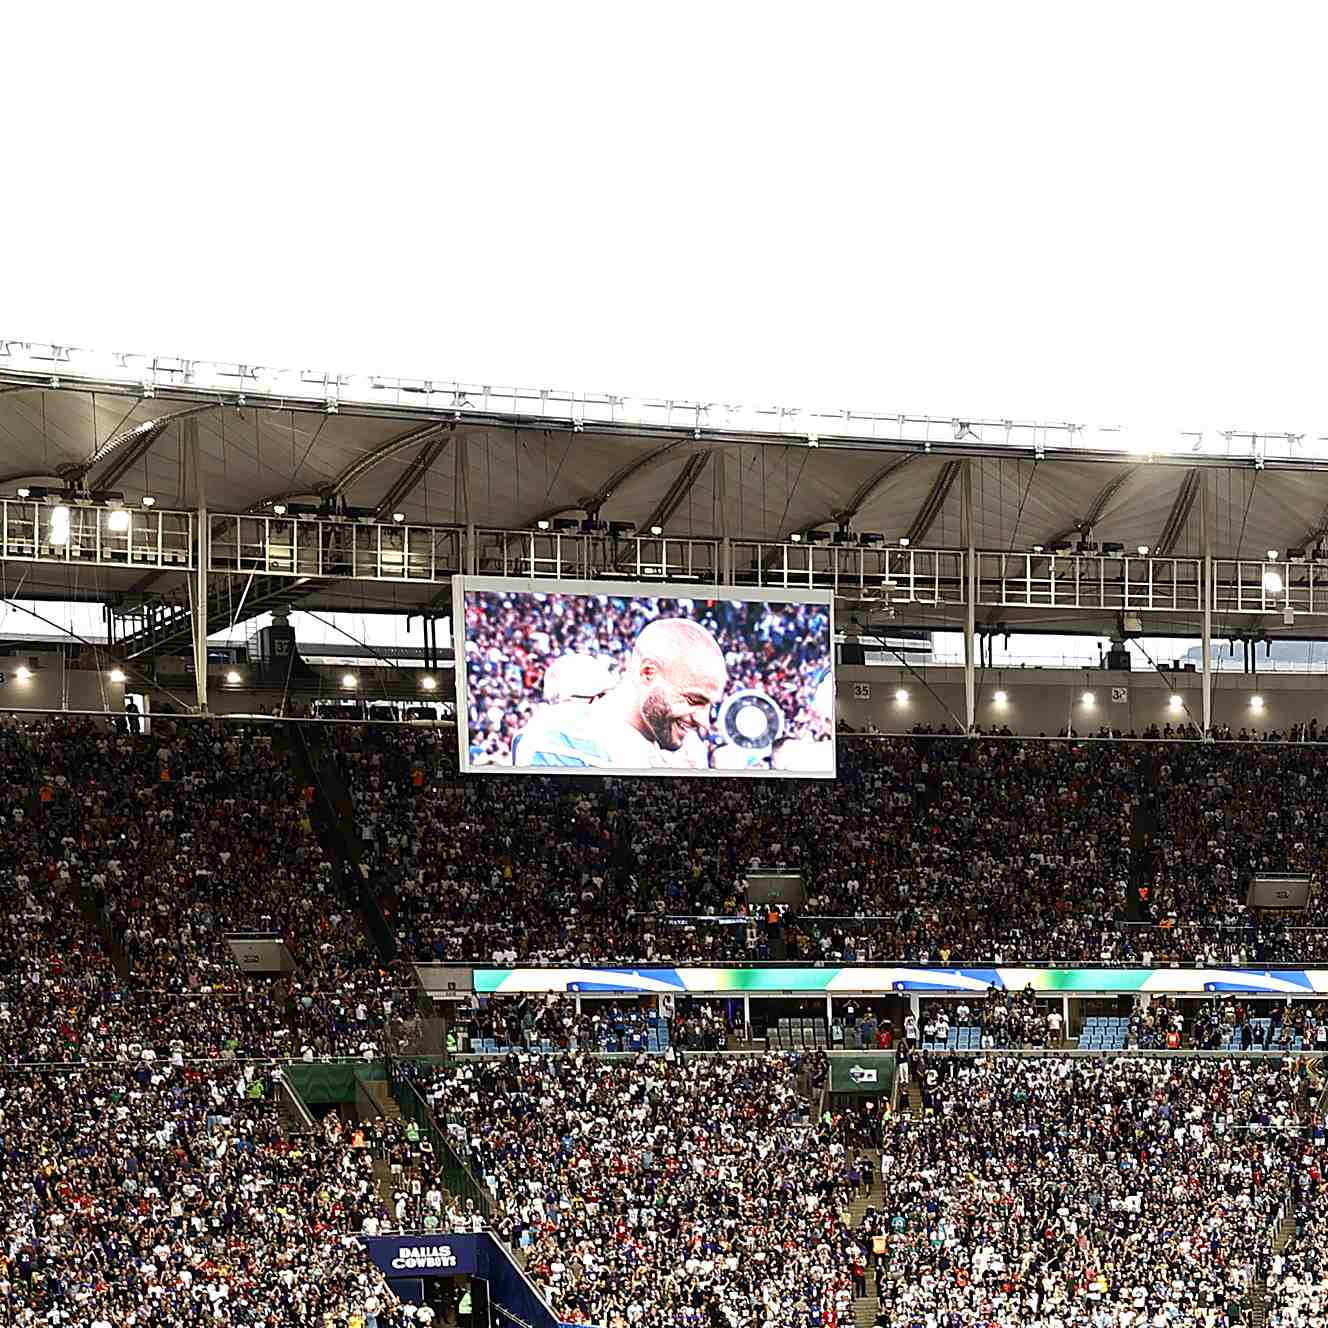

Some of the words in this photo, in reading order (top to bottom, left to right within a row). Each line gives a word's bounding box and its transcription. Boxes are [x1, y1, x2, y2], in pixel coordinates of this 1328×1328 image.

[855, 684, 869, 696] 35
[399, 1246, 452, 1259] DALLAS
[391, 1255, 457, 1269] COWBOYS
